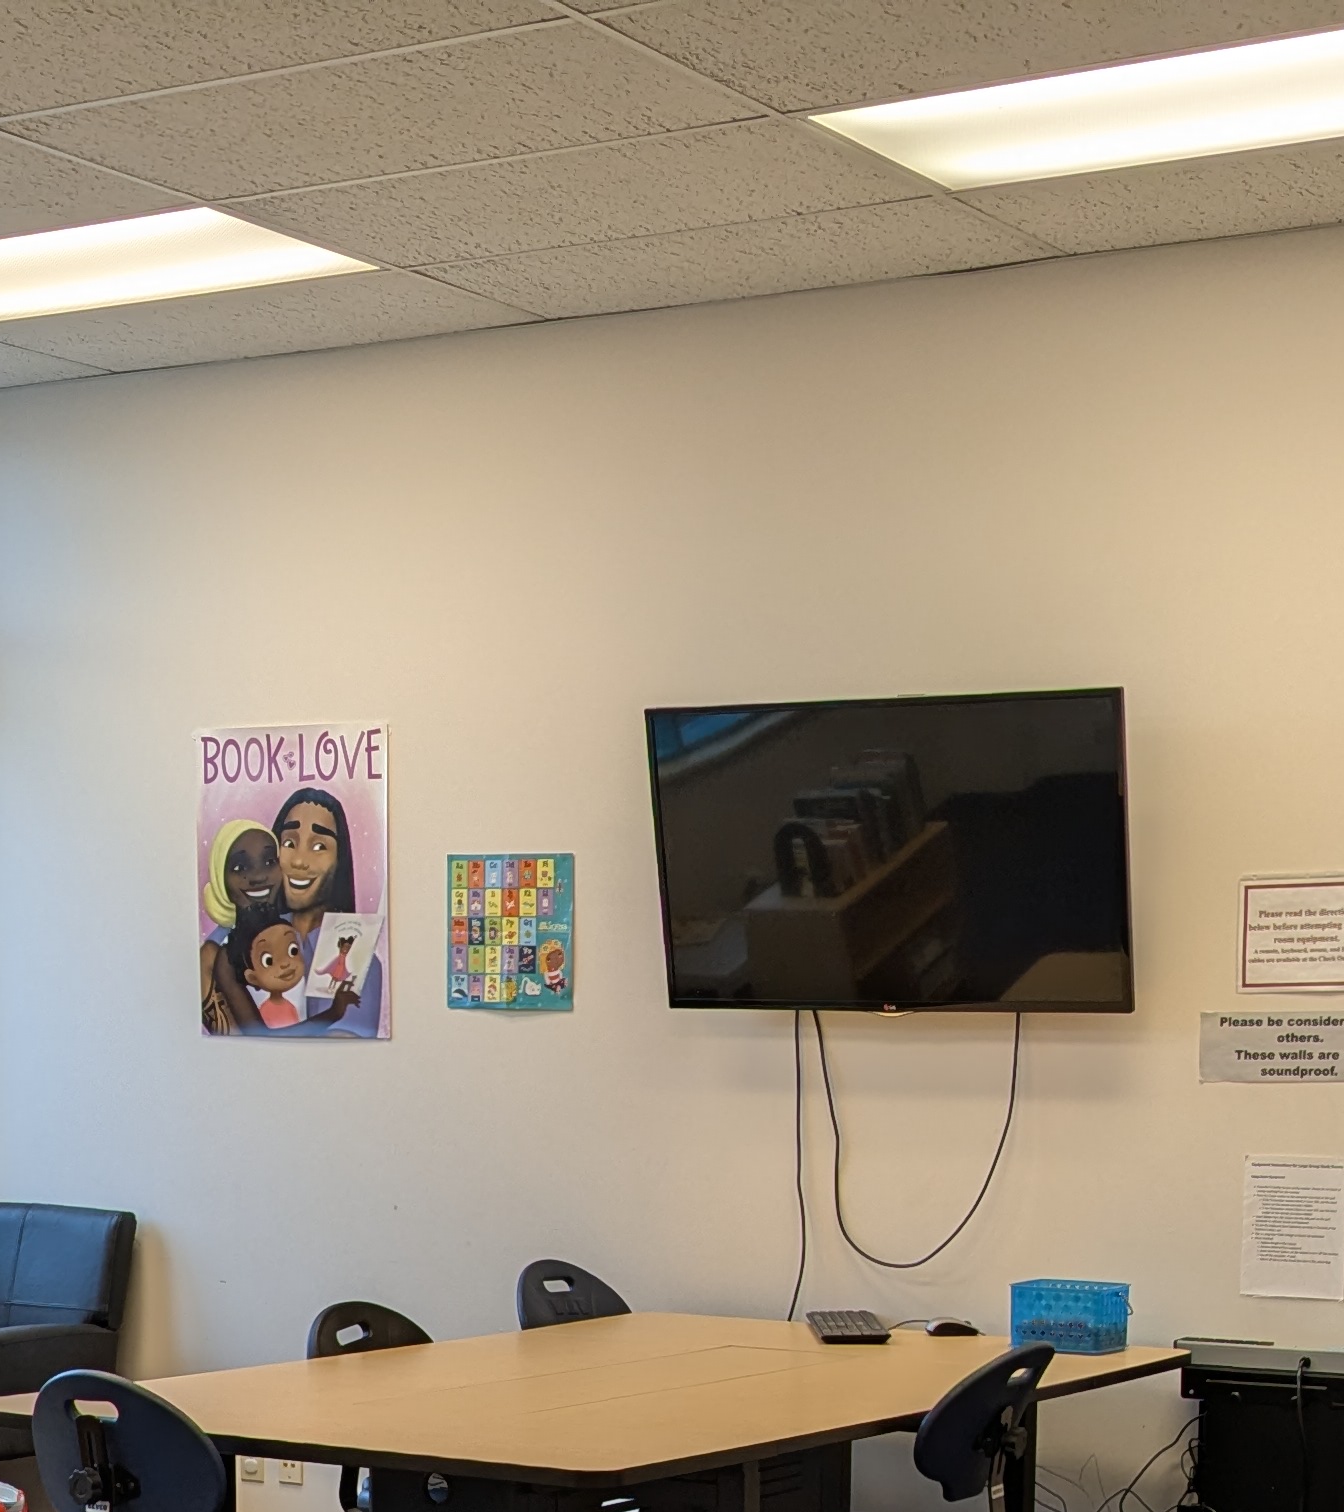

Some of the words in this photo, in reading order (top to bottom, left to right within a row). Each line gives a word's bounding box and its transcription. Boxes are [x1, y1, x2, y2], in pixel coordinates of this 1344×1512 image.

[200, 733, 285, 784] BOOK
[298, 728, 383, 782] LOVE
[1219, 1016, 1263, 1027] Please
[1267, 1016, 1283, 1027] be
[1276, 1032, 1324, 1043] others.
[1234, 1049, 1275, 1061] These
[1278, 1049, 1314, 1061] walls
[1317, 1051, 1340, 1061] are
[1260, 1065, 1338, 1079] soundproof.
